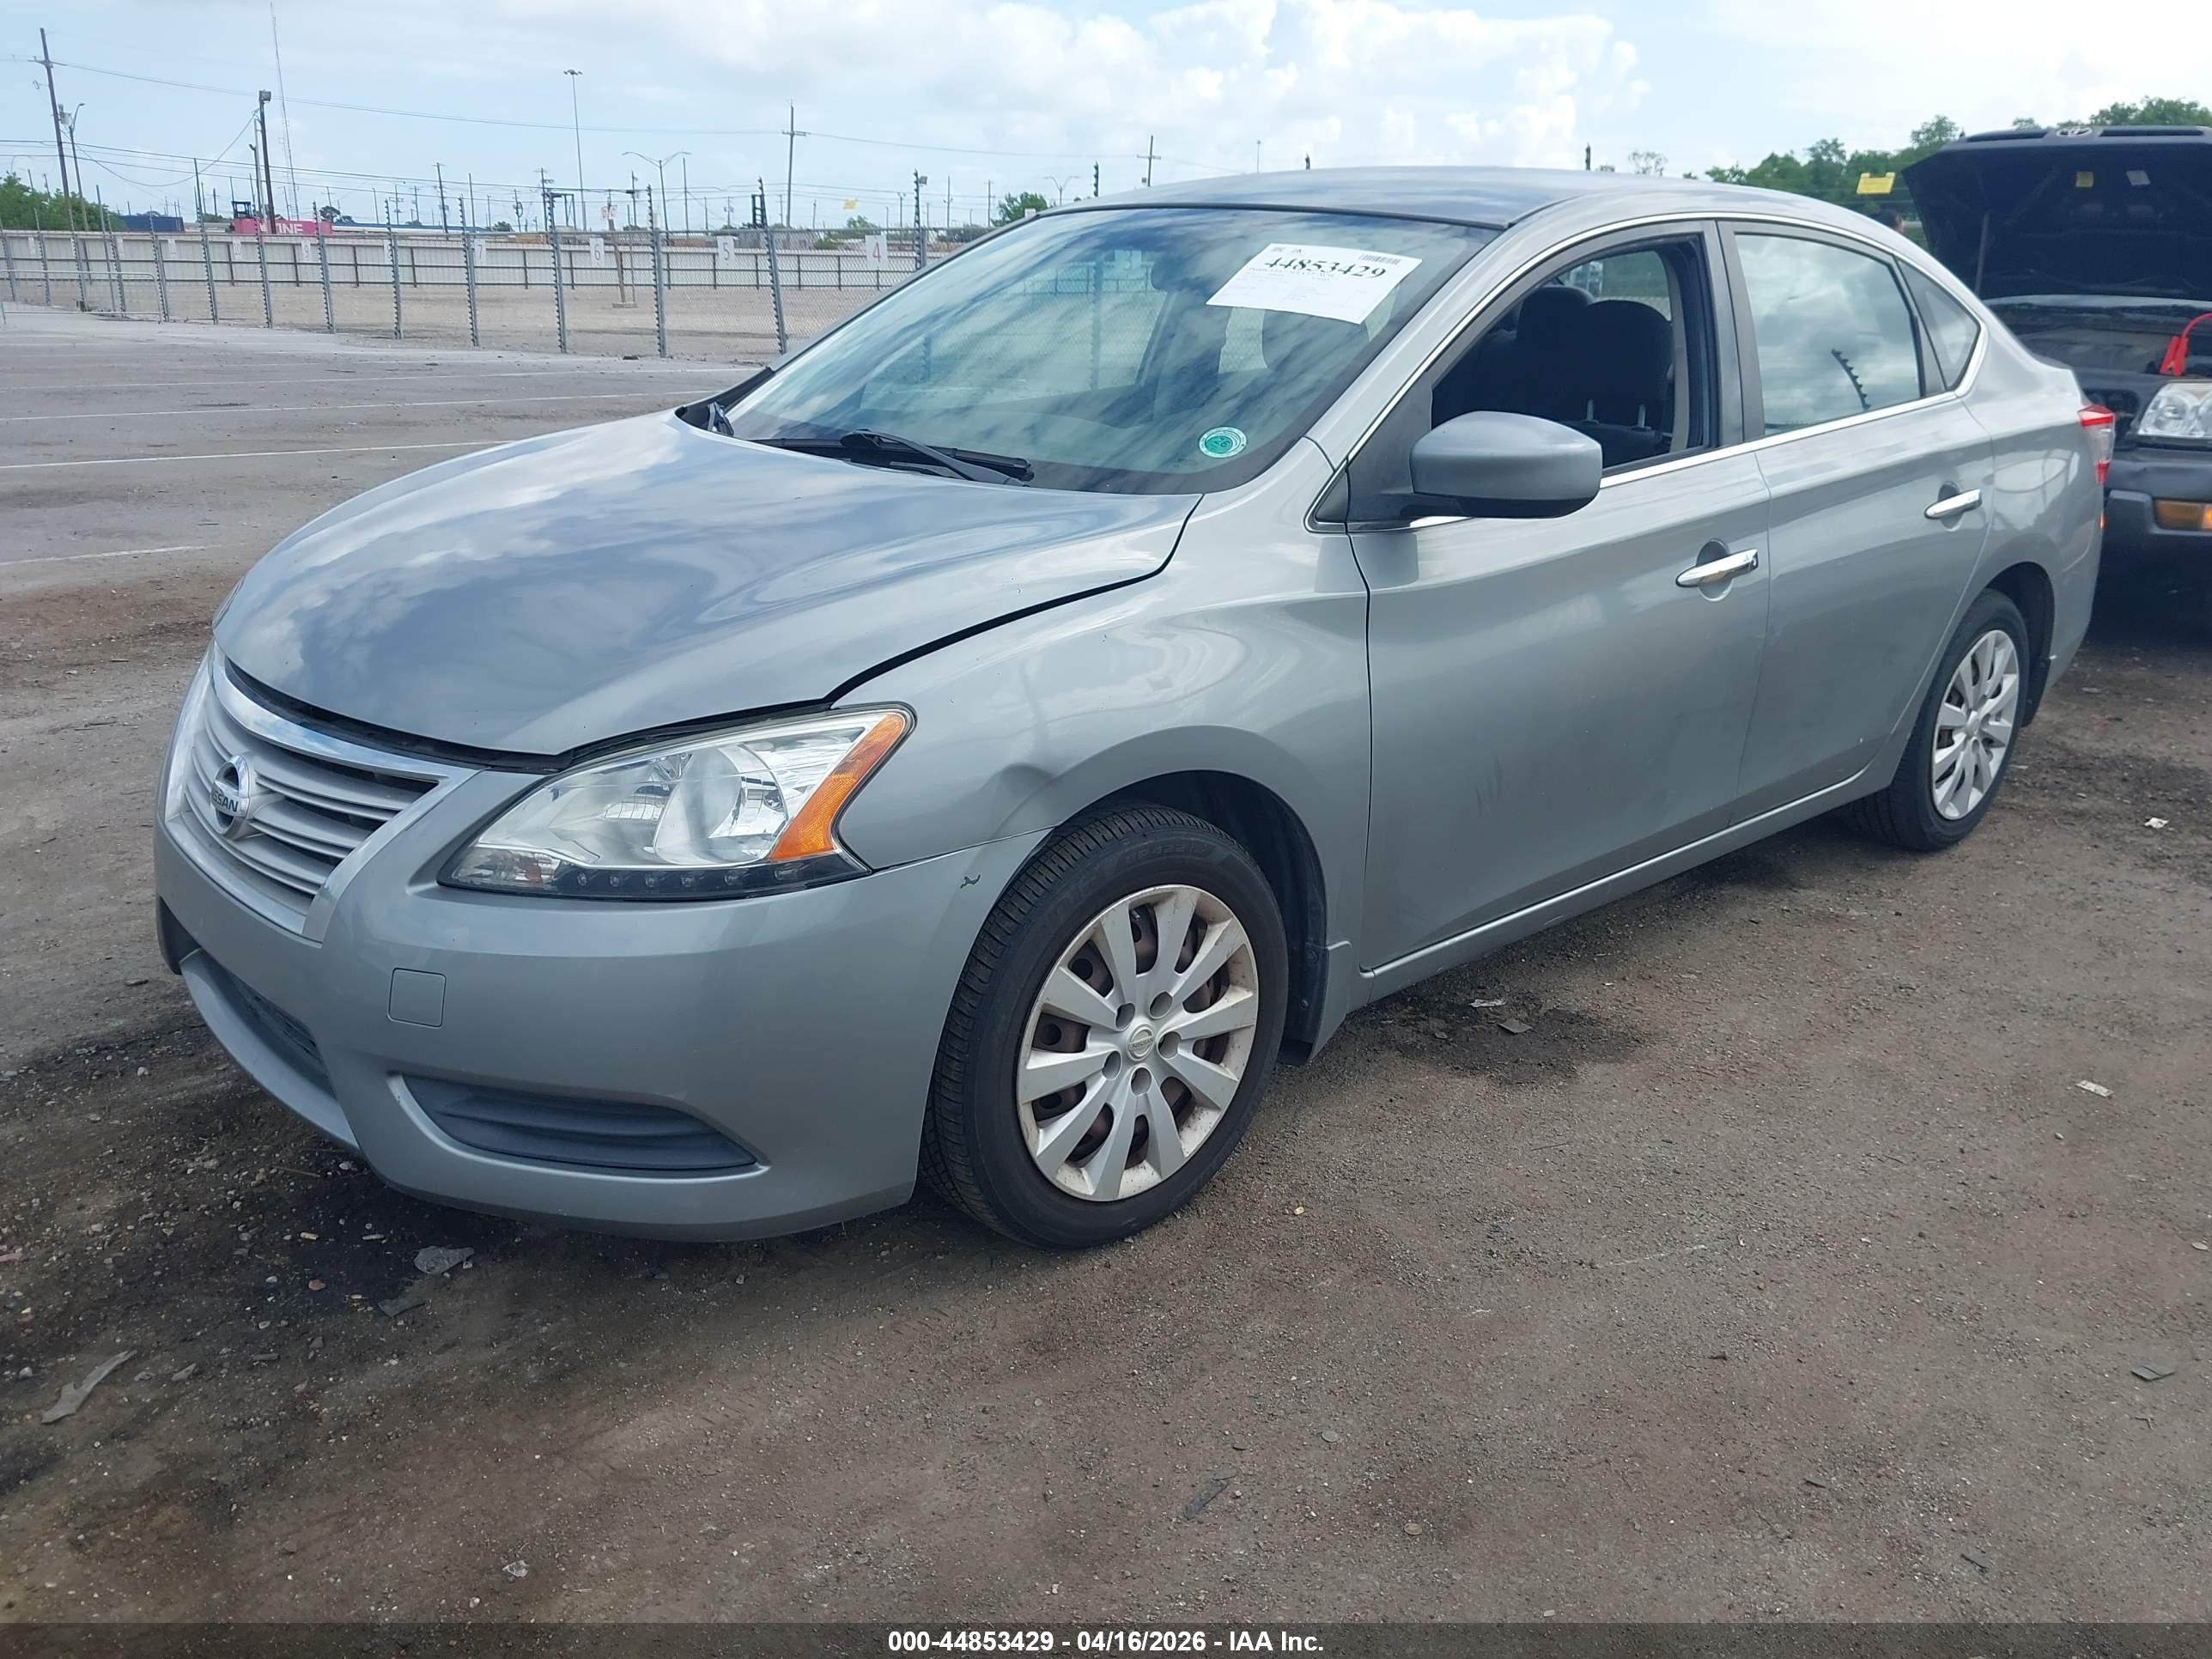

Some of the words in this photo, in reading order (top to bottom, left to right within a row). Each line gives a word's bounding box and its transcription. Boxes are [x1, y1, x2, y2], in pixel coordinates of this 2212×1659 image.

[594, 243, 601, 261] 6
[722, 241, 730, 261] 5
[872, 241, 882, 262] 4
[1264, 257, 1387, 278] 44853429
